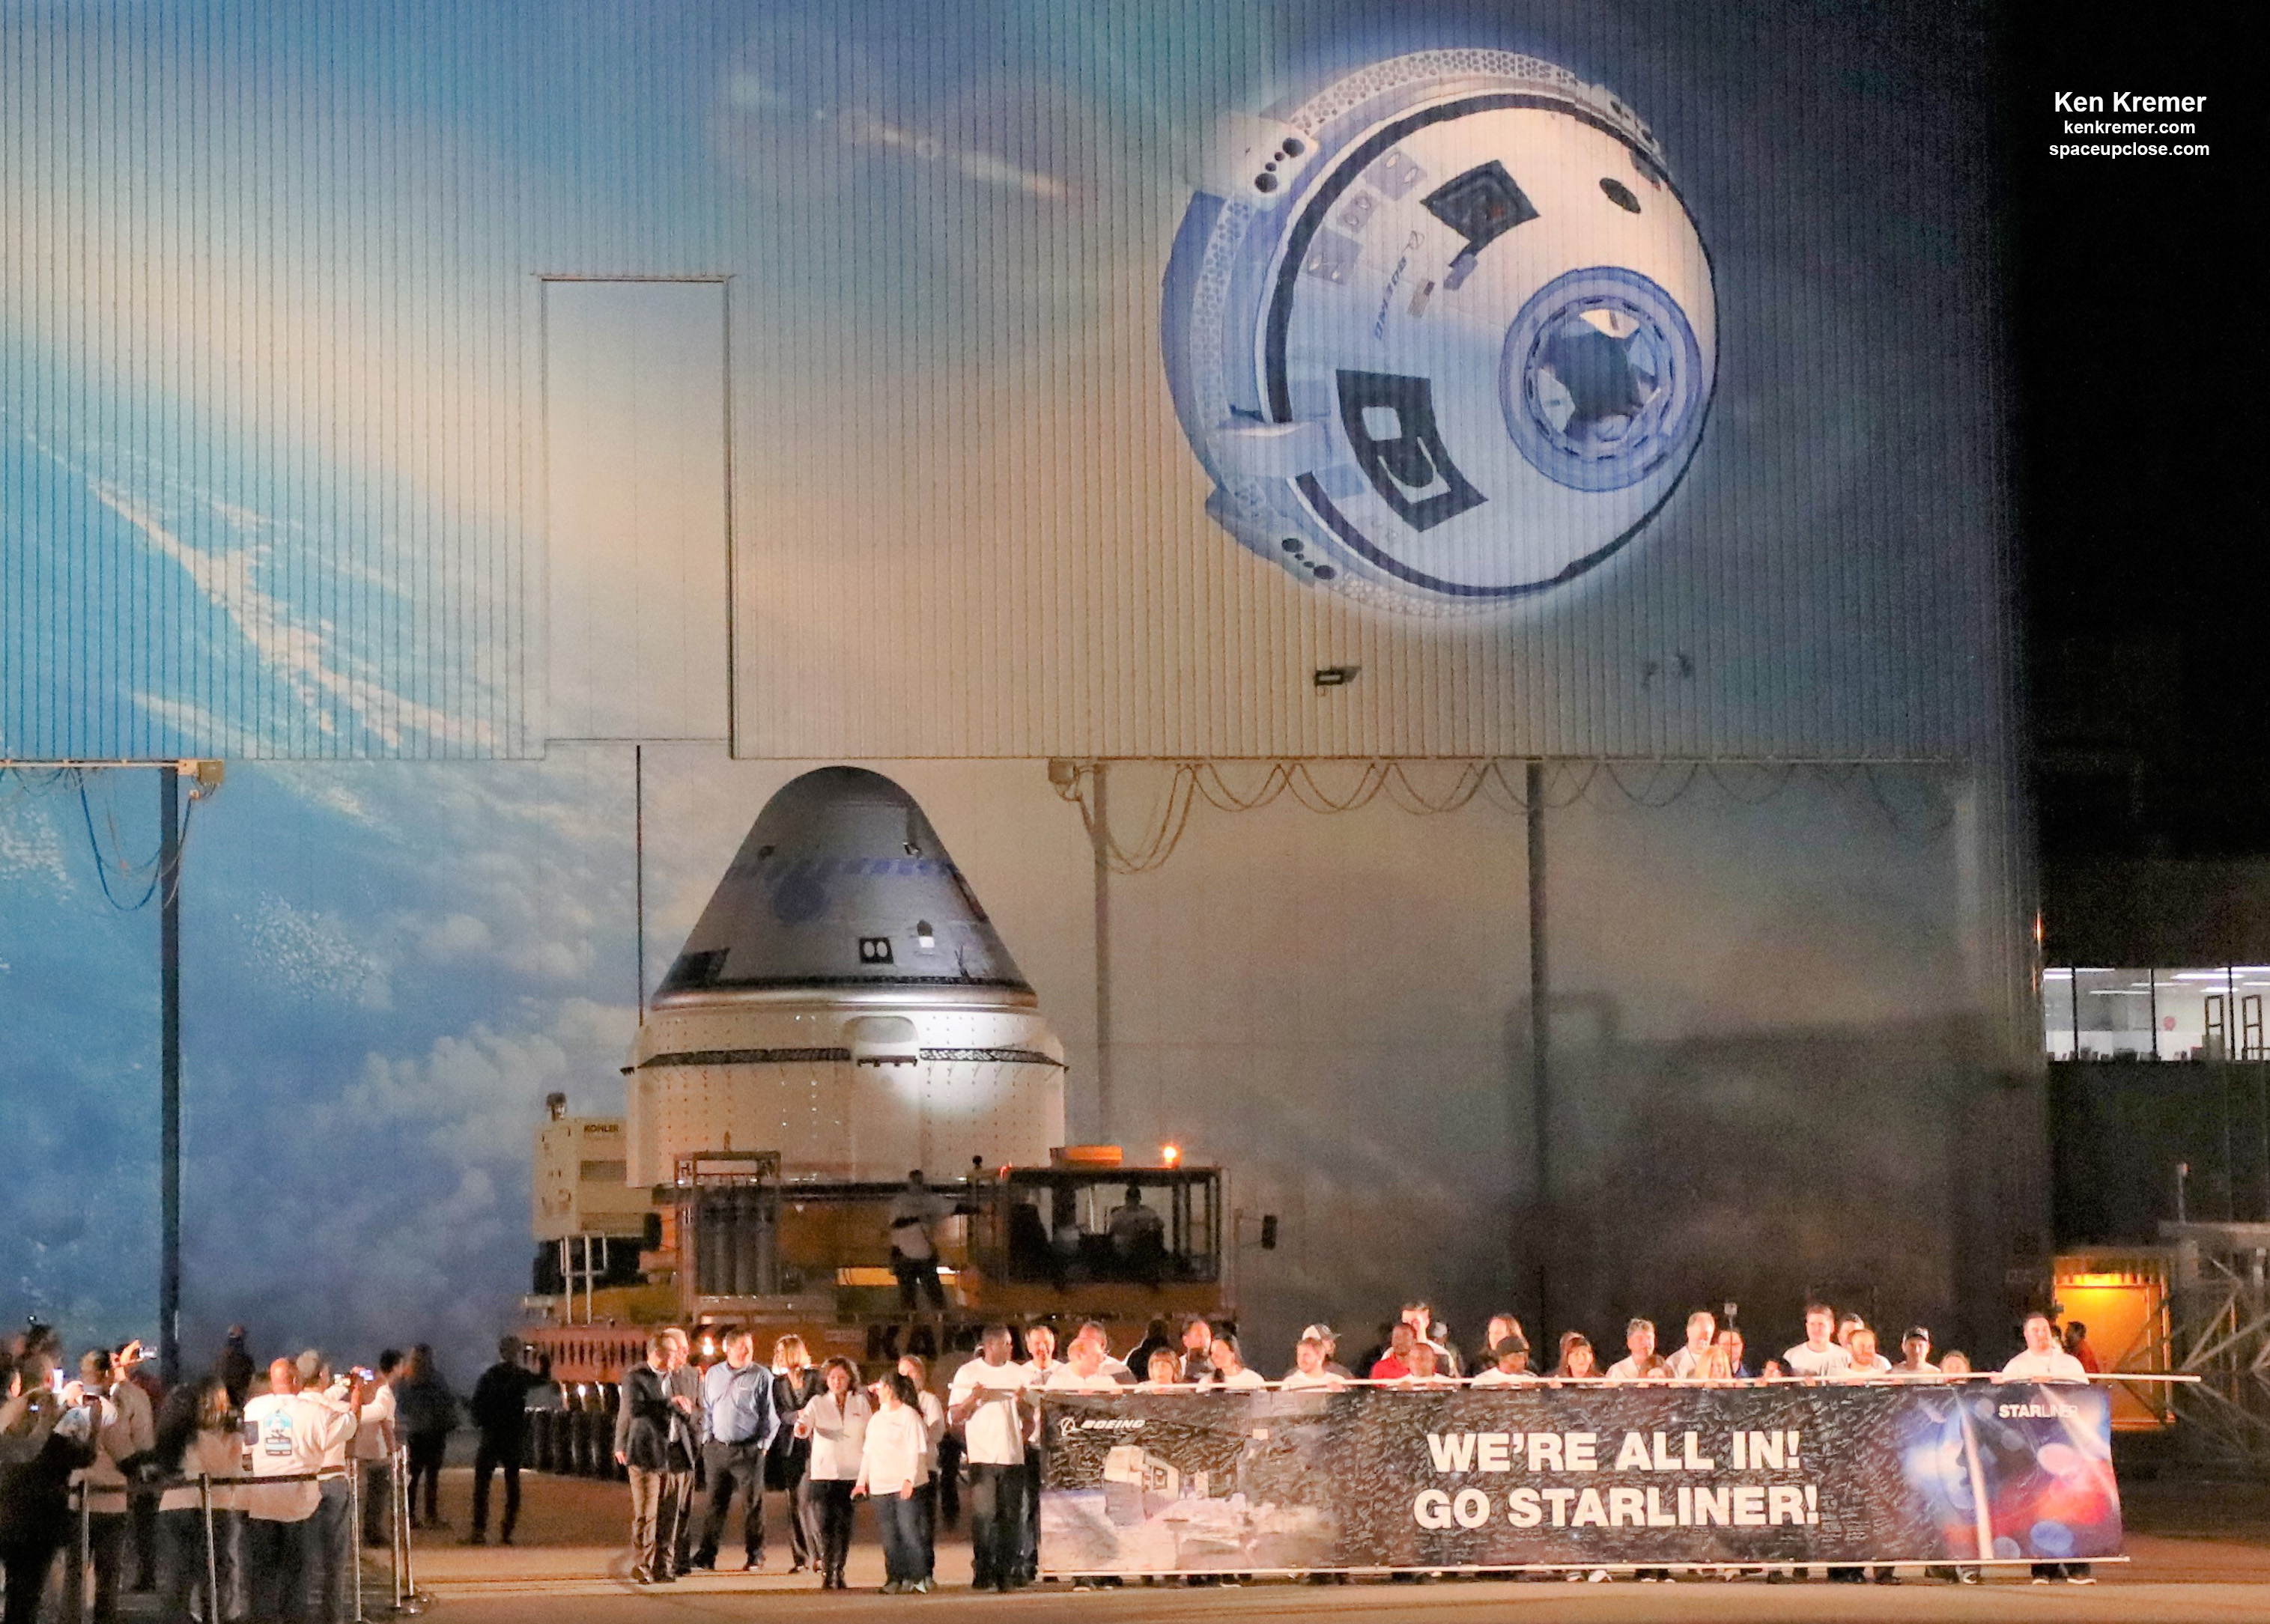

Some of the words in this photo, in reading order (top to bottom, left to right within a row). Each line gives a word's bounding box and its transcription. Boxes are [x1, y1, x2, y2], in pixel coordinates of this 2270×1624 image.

[1081, 1420, 1145, 1429] BOEING
[1998, 1404, 2078, 1418] STARLINER
[1427, 1432, 1597, 1472] WE'RE
[1615, 1431, 1714, 1470] ALL
[1733, 1431, 1800, 1469] IN!
[1414, 1488, 1490, 1529] GO
[1508, 1485, 1819, 1528] STARLINER!
